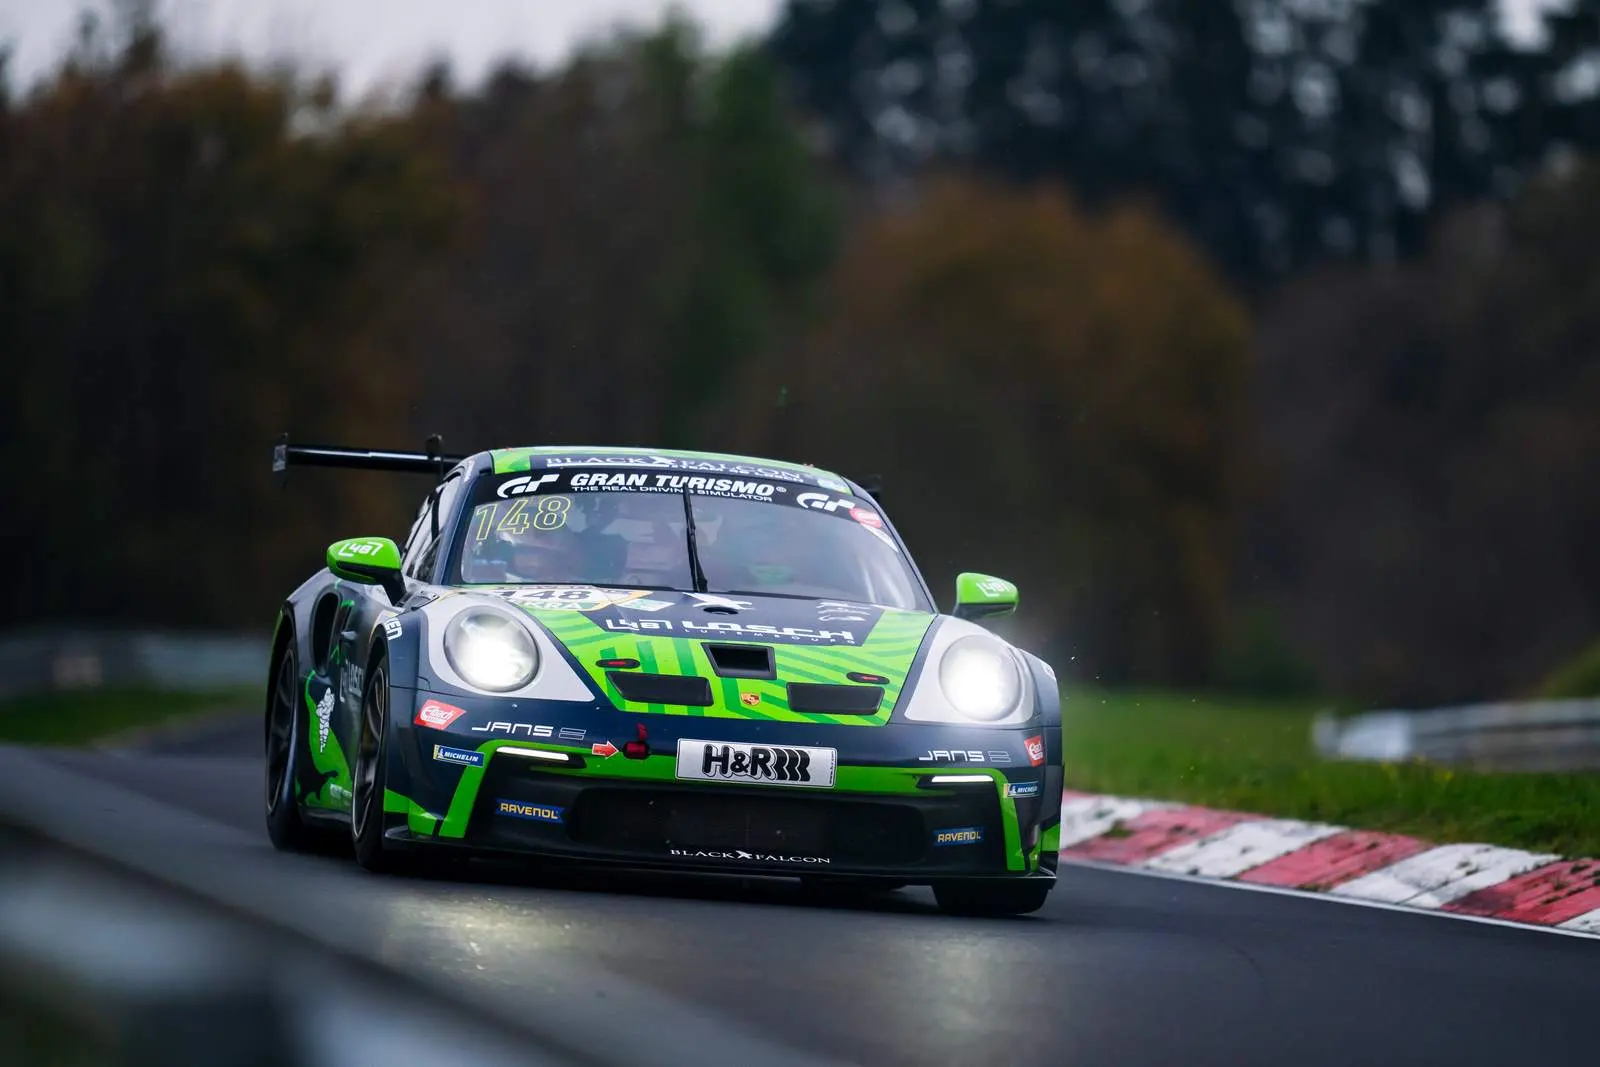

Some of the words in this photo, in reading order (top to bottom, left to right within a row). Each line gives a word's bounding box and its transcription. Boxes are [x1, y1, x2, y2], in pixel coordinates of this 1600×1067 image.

[570, 473, 648, 487] GRAN
[697, 489, 773, 502] SIMULATOR
[475, 495, 572, 541] 148
[472, 721, 554, 738] JANS
[444, 752, 479, 762] MICHELIN
[918, 750, 985, 763] JANS
[500, 802, 559, 820] RAVENOL
[937, 831, 982, 843] RAVENOL
[670, 849, 735, 859] BLACK
[755, 854, 831, 863] FALCON
